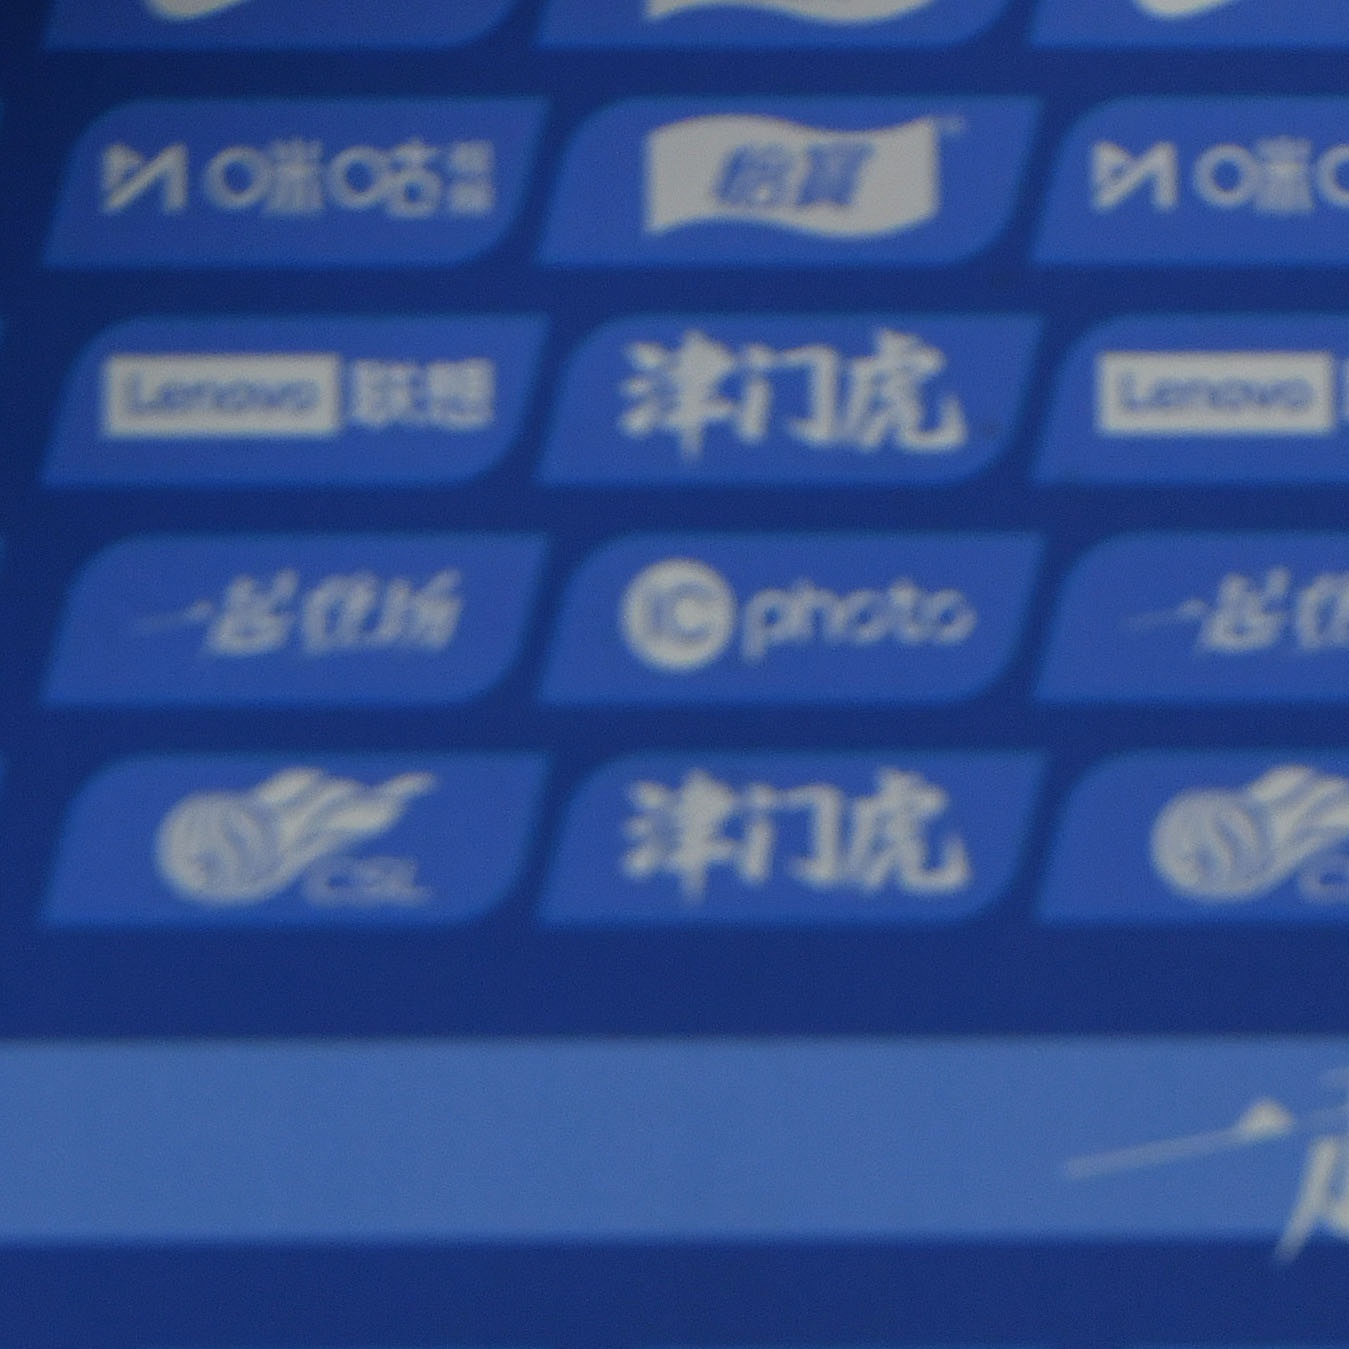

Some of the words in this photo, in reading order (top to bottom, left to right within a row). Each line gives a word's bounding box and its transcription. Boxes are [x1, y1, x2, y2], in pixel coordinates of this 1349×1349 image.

[348, 358, 494, 429] 联想
[621, 329, 967, 458] 津门虎
[1118, 369, 1314, 415] Lenovo
[623, 768, 971, 903] 津门虎
